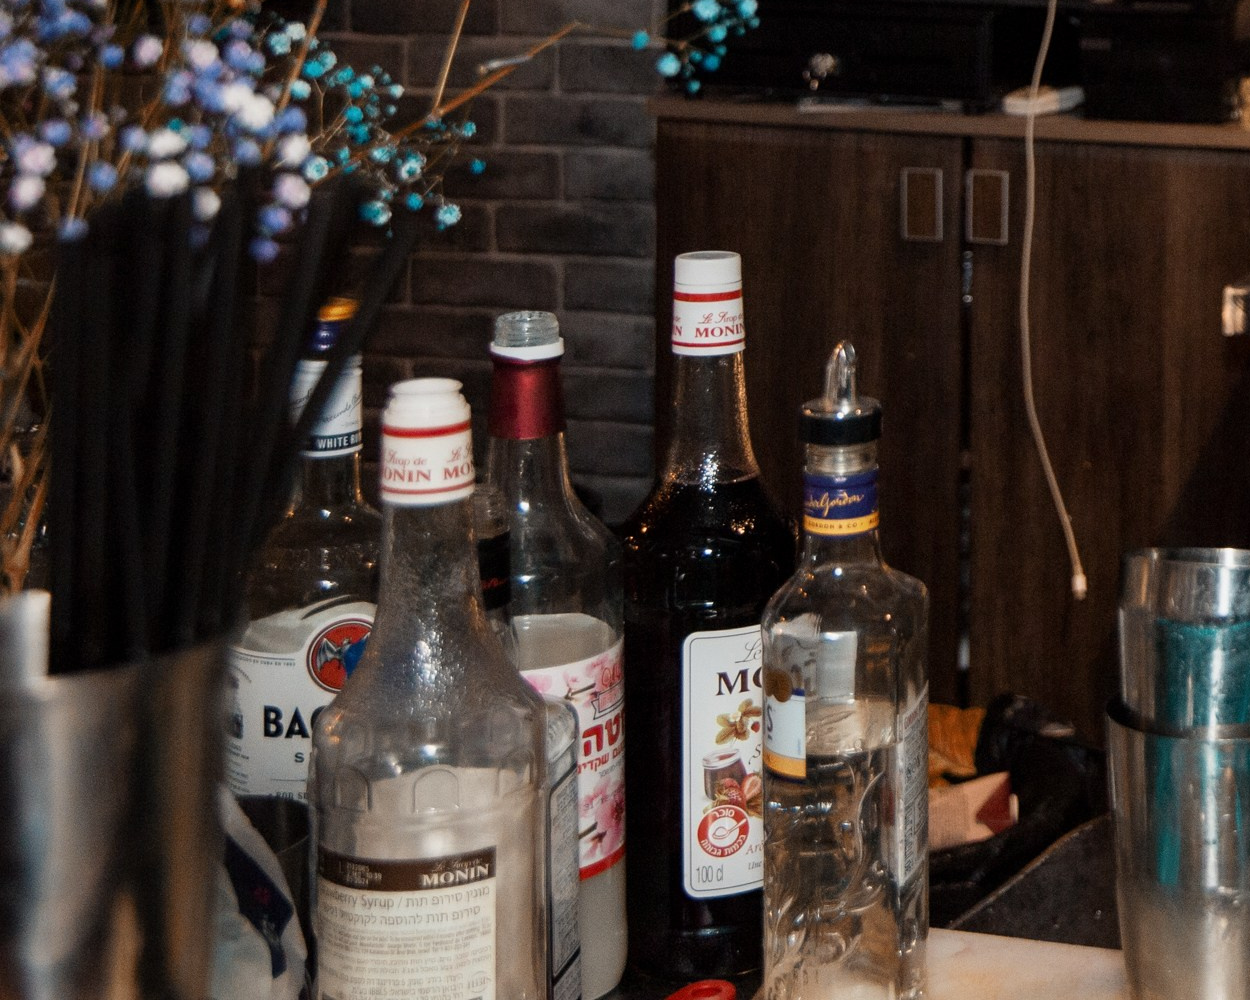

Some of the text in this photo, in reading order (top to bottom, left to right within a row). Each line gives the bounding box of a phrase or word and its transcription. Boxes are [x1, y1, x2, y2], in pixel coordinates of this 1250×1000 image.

[695, 323, 745, 338] MONIN
[317, 435, 349, 449] WHITE
[383, 465, 431, 483] ONIN
[711, 808, 735, 819] סוכר
[421, 864, 490, 886] MONIN
[695, 863, 724, 884] 100 cl
[361, 895, 395, 911] Syrup
[405, 897, 427, 908] תות
[426, 912, 449, 925] תות
